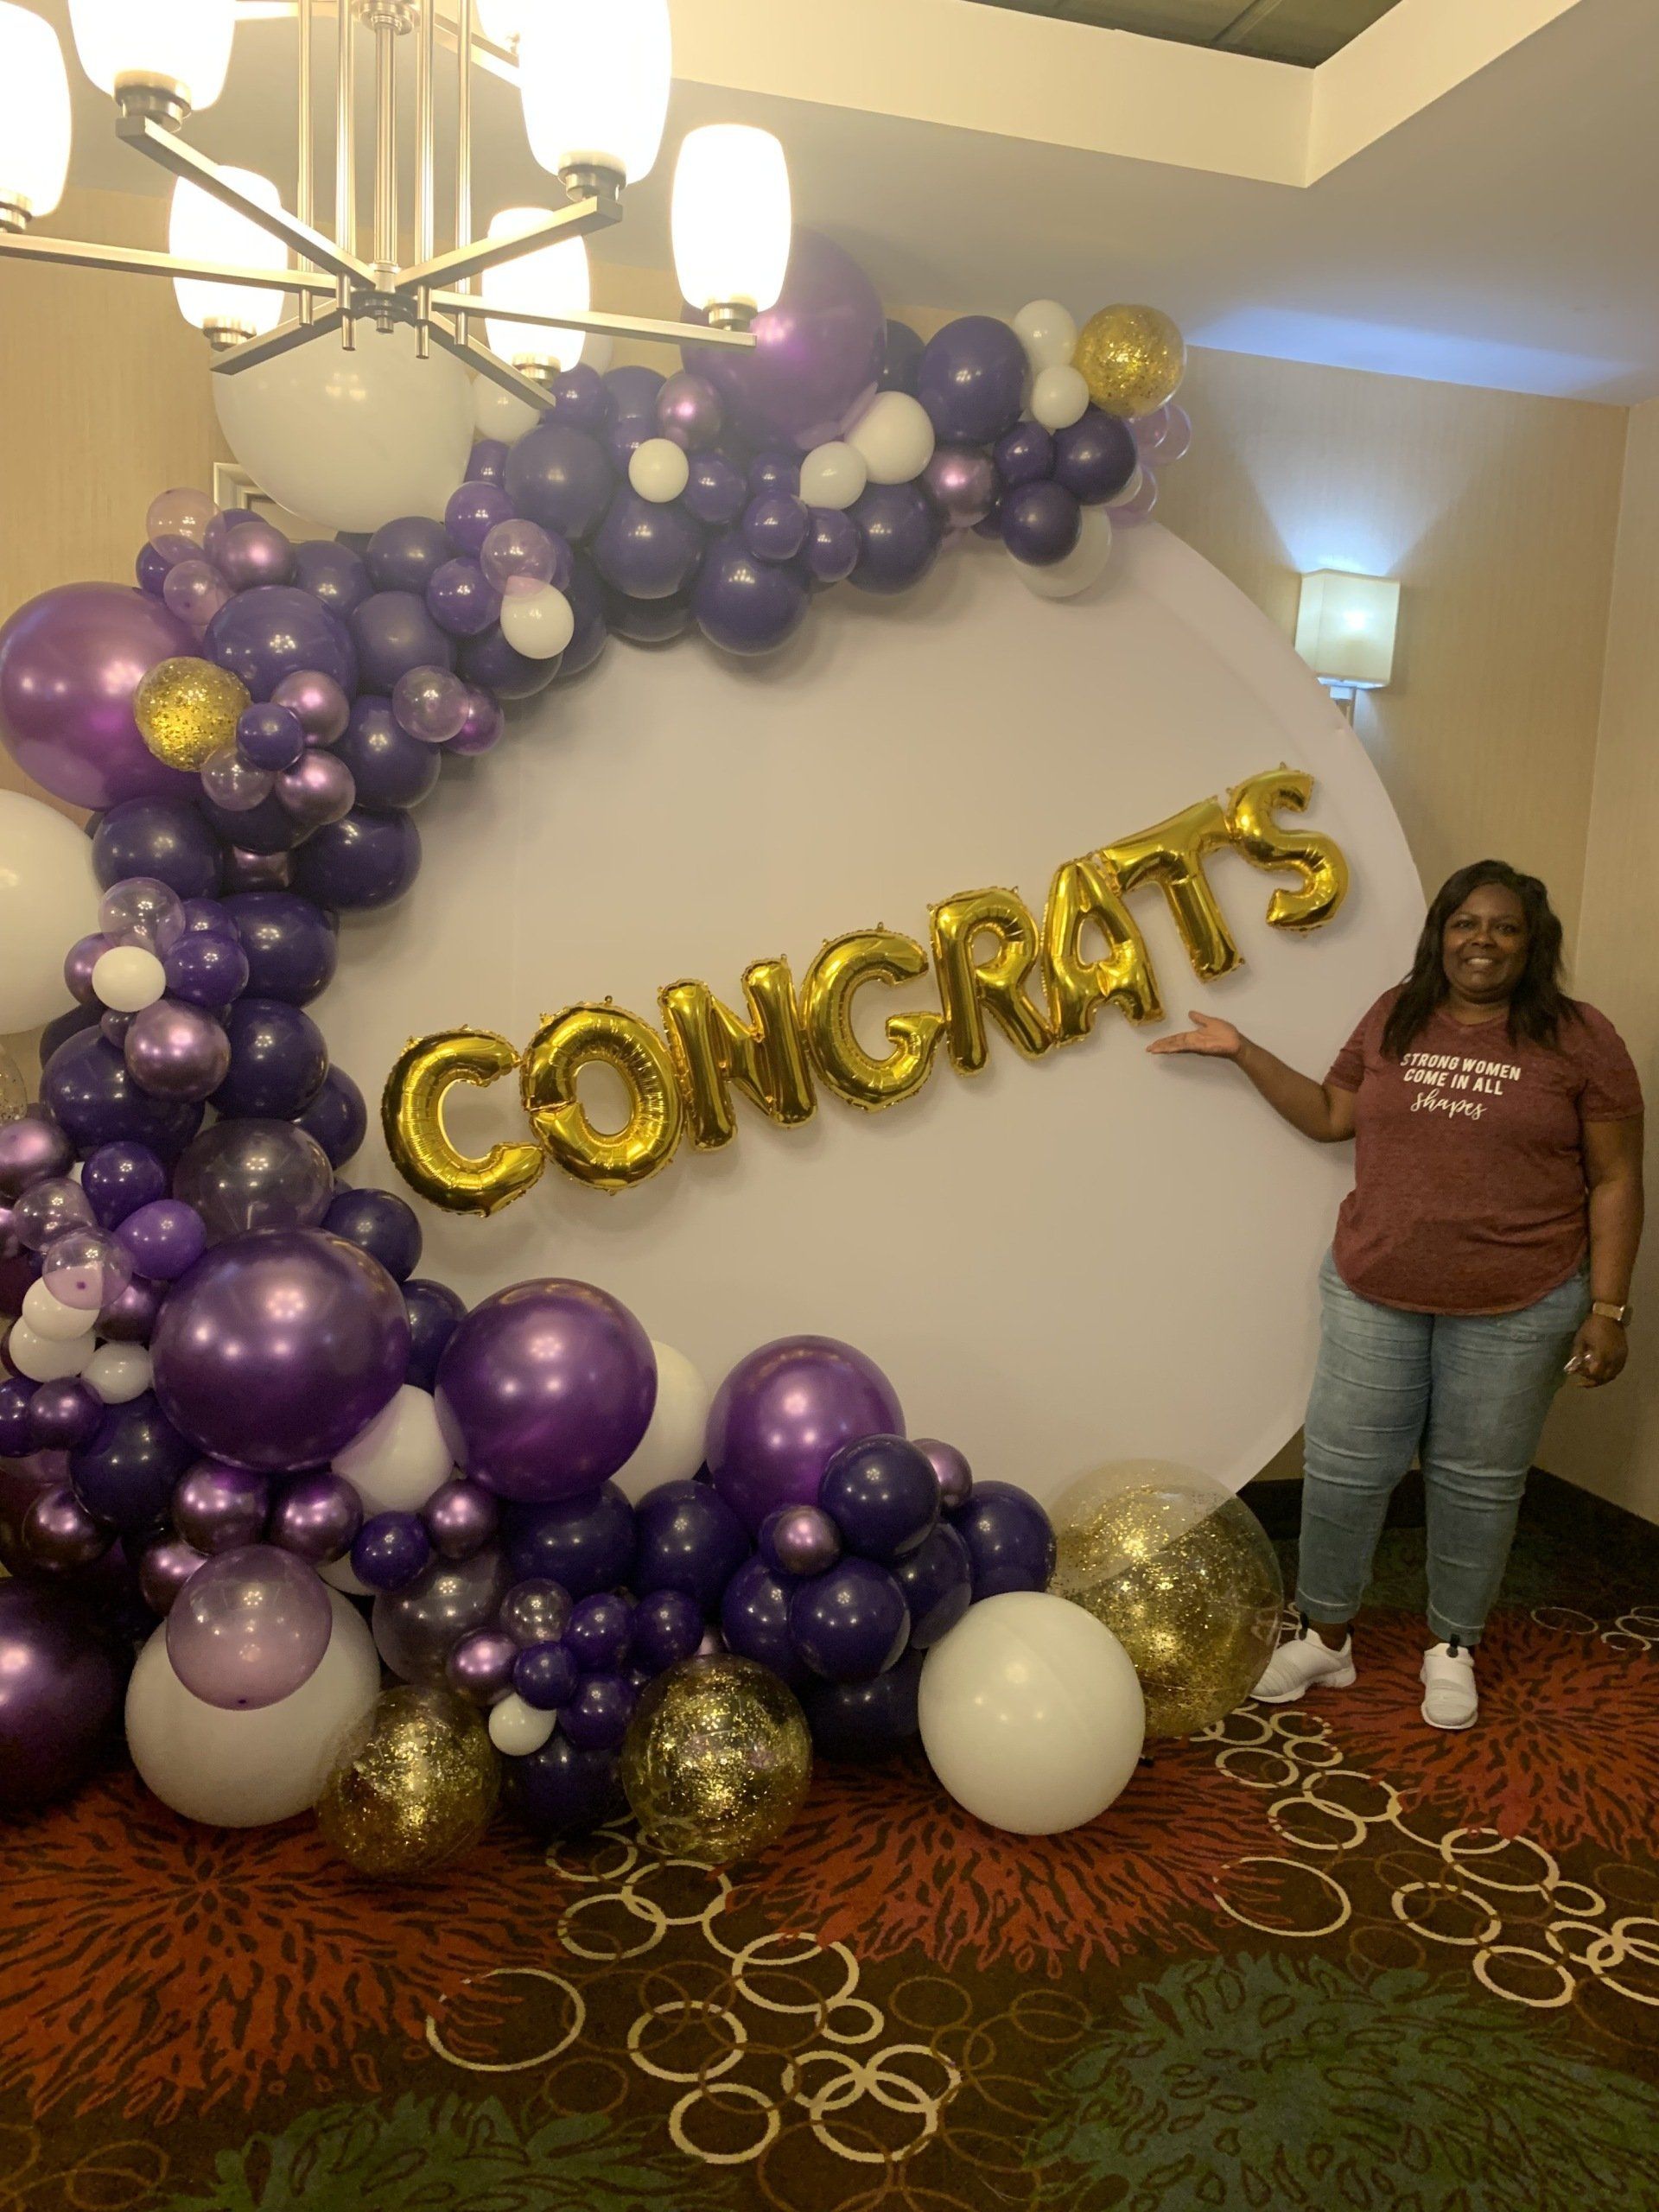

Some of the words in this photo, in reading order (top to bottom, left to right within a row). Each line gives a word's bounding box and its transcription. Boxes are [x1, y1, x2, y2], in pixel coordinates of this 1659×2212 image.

[381, 763, 1351, 1217] CONGRATS
[1400, 1052, 1460, 1071] STRONG
[1462, 1058, 1522, 1081] WOMEN
[1403, 1068, 1449, 1087] COME
[1450, 1074, 1470, 1090] IN
[1472, 1077, 1503, 1096] ALL
[1410, 1088, 1487, 1120] shapes
